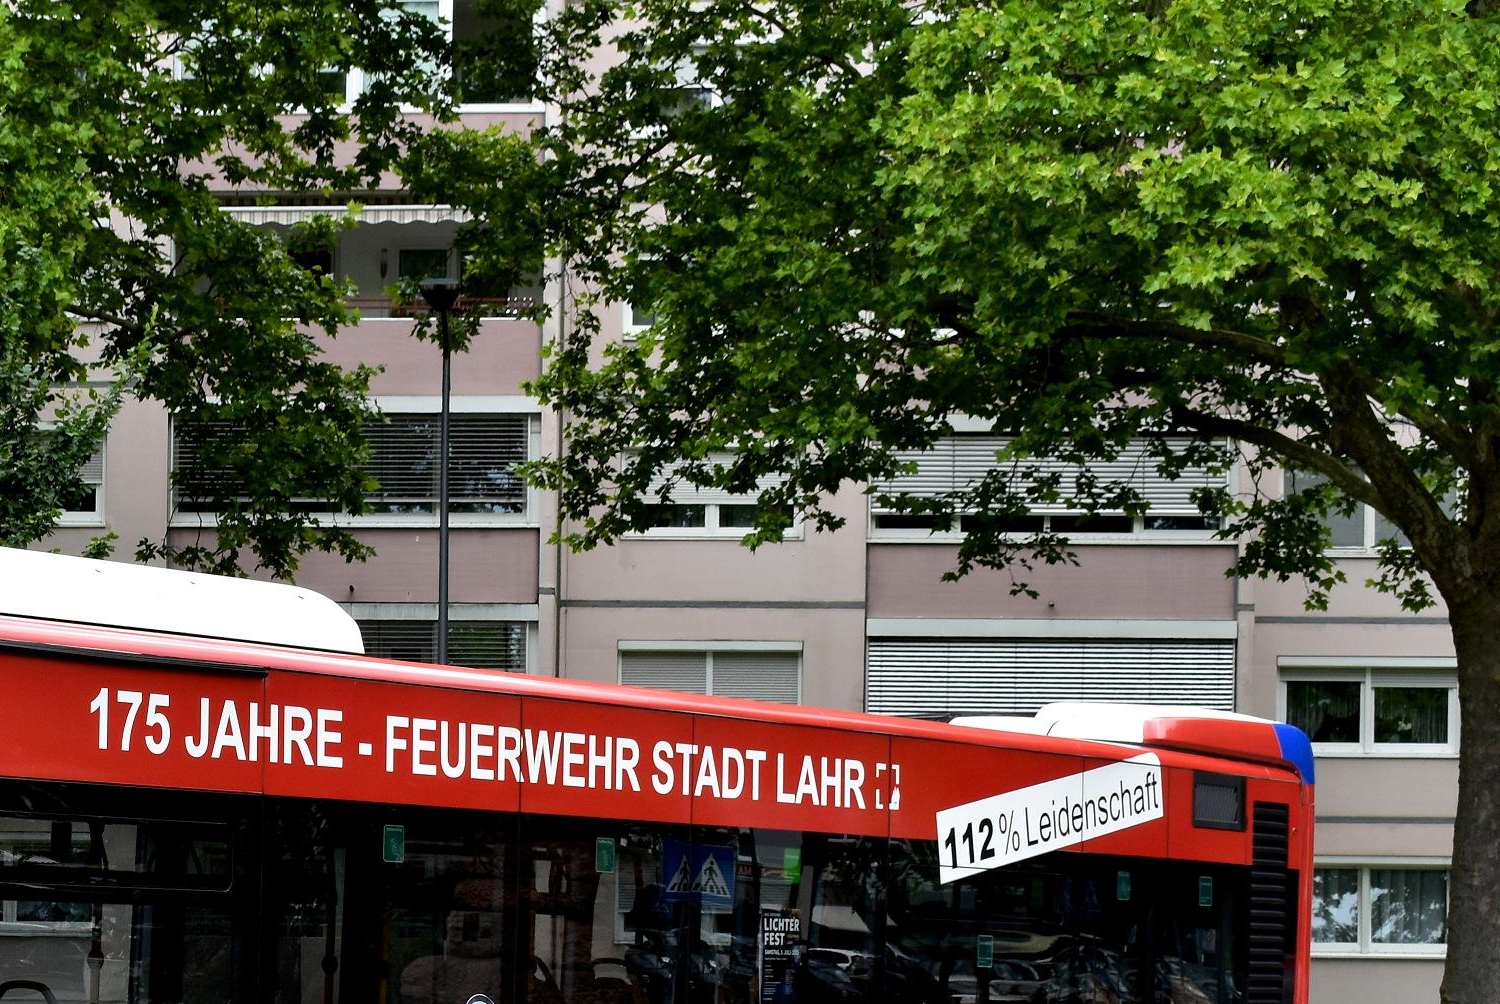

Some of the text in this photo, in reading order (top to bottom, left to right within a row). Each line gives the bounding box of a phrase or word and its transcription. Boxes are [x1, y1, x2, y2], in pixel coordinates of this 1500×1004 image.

[90, 687, 866, 810] 175 JAHRE - FEUERWEHR STADT LAHR
[1025, 772, 1159, 847] Leidenschaft
[764, 918, 799, 932] LICHTER
[764, 933, 785, 946] FEST
